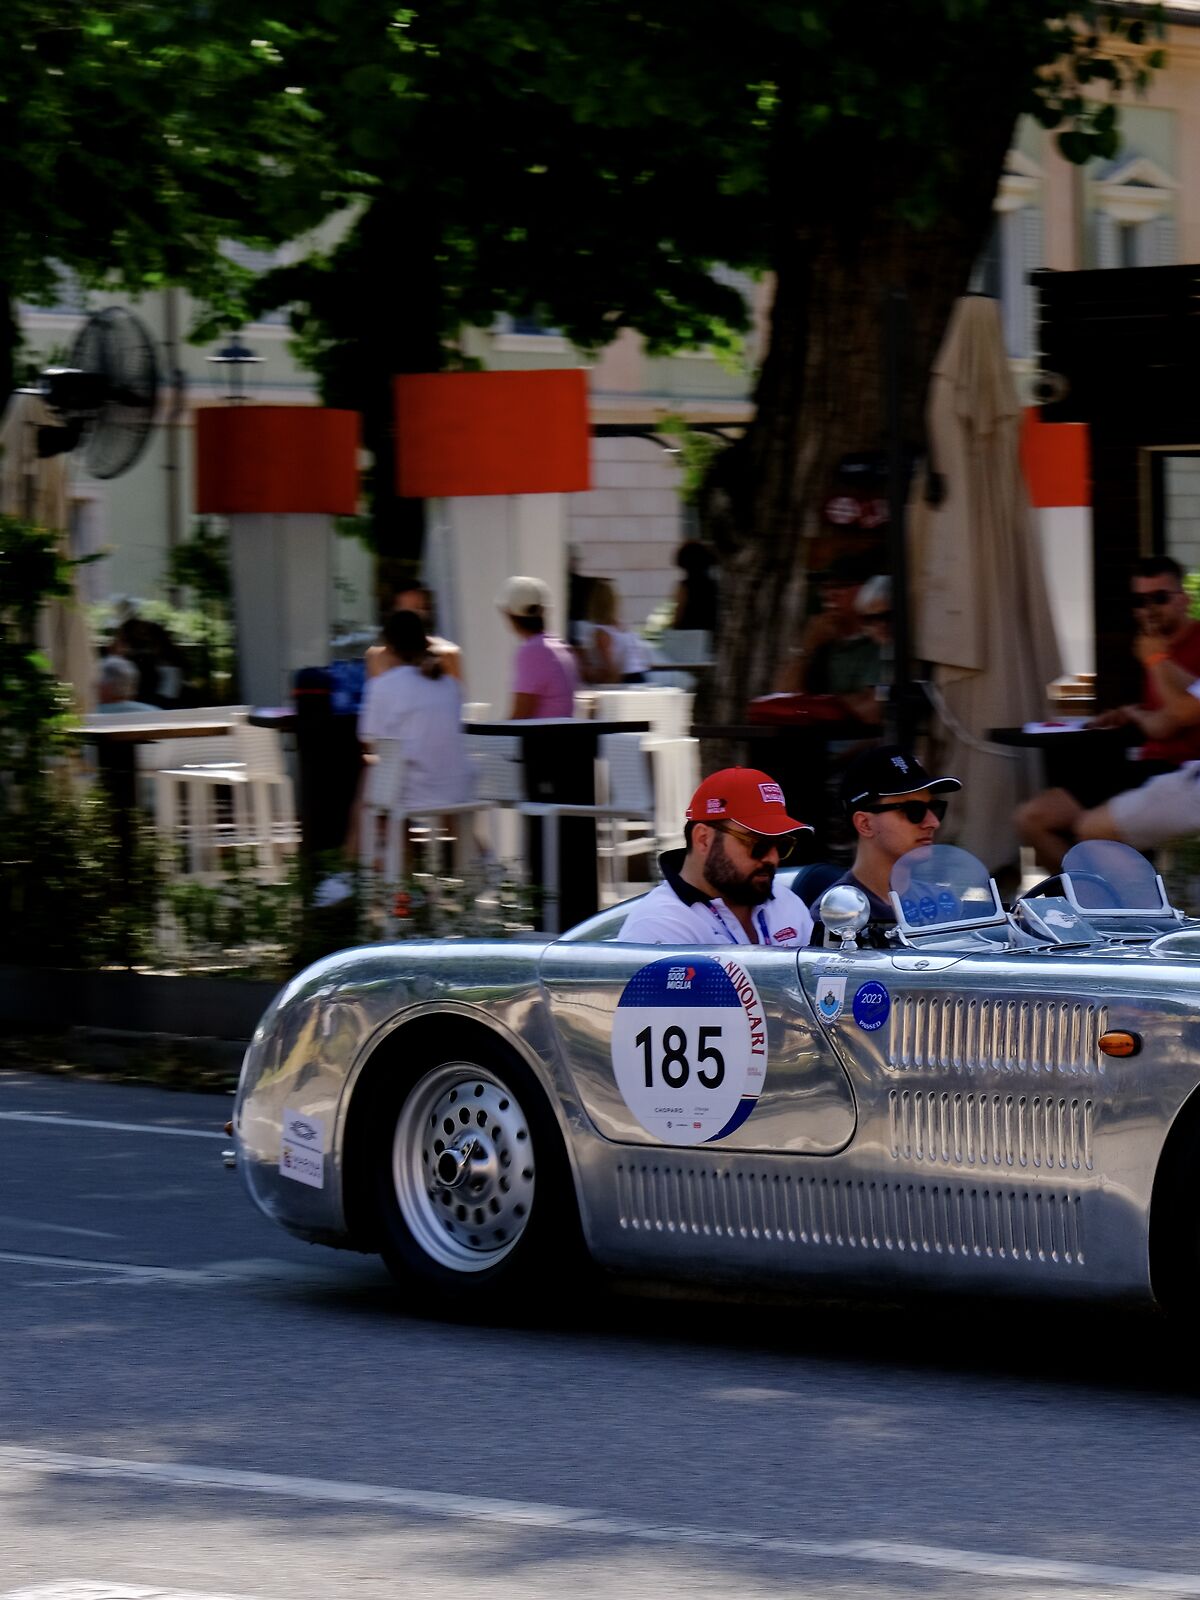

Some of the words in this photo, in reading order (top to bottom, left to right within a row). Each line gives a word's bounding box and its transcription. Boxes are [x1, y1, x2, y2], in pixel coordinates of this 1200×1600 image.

[667, 972, 686, 980] 1000
[666, 980, 692, 989] MIGLIA
[861, 993, 882, 1004] 2023
[724, 960, 765, 1056] NUVOLARI
[635, 1025, 725, 1090] 185
